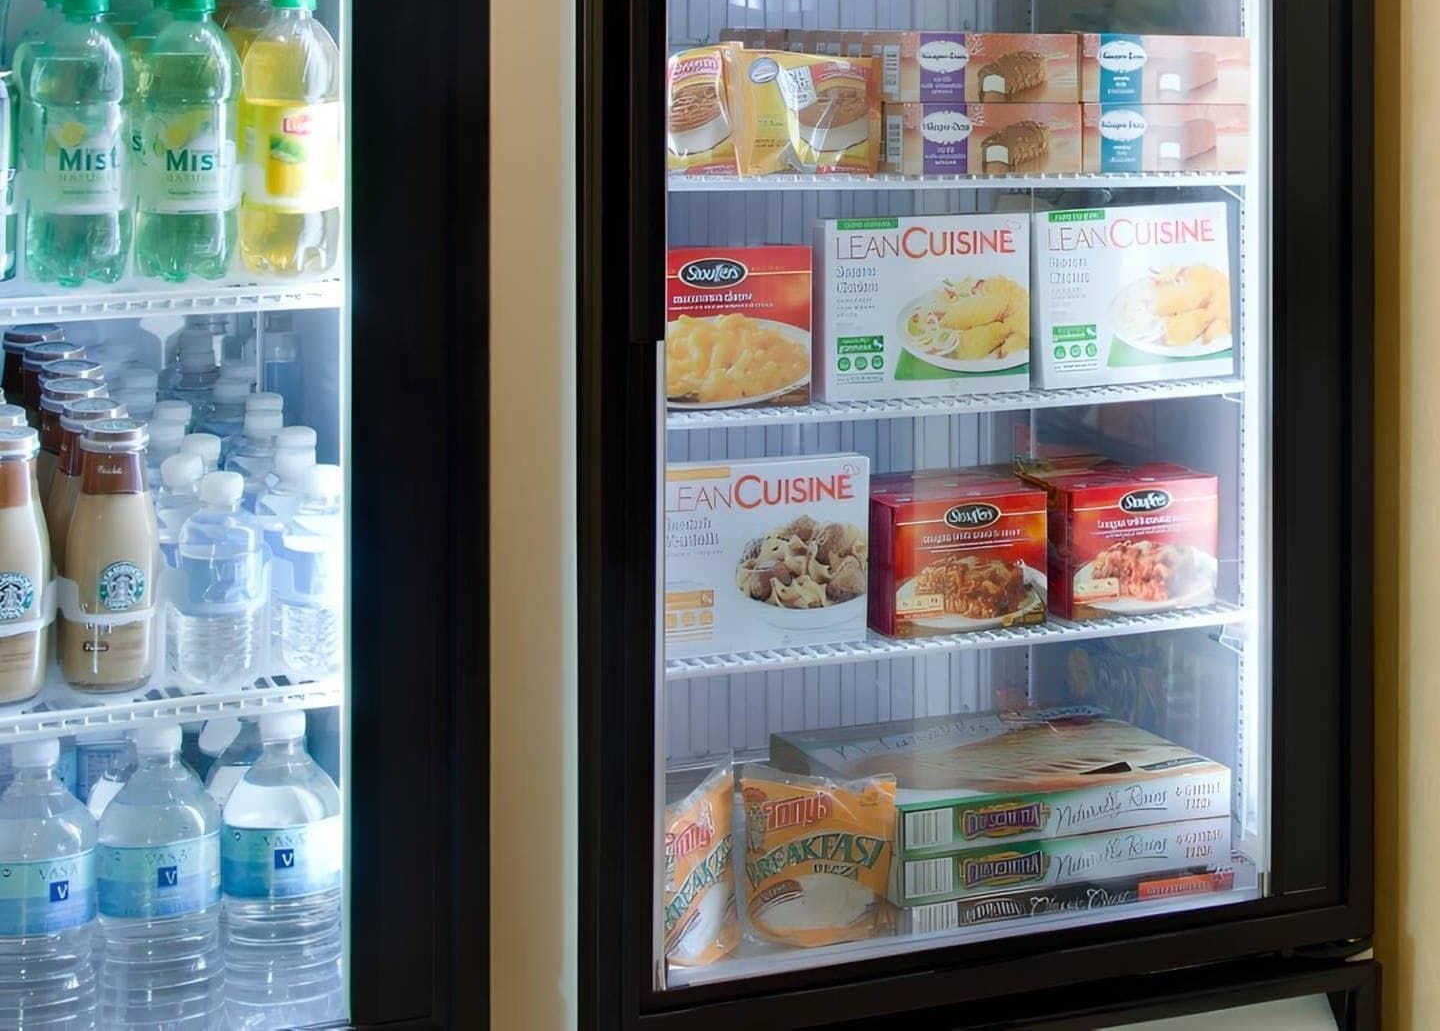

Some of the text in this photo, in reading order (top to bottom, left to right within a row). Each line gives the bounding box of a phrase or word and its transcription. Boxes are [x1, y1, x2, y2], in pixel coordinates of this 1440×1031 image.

[60, 146, 121, 171] Mist
[836, 226, 1017, 260] LEAN CUISINE
[1047, 219, 1216, 251] LEAN CUISINE
[734, 474, 855, 510] CUISINE
